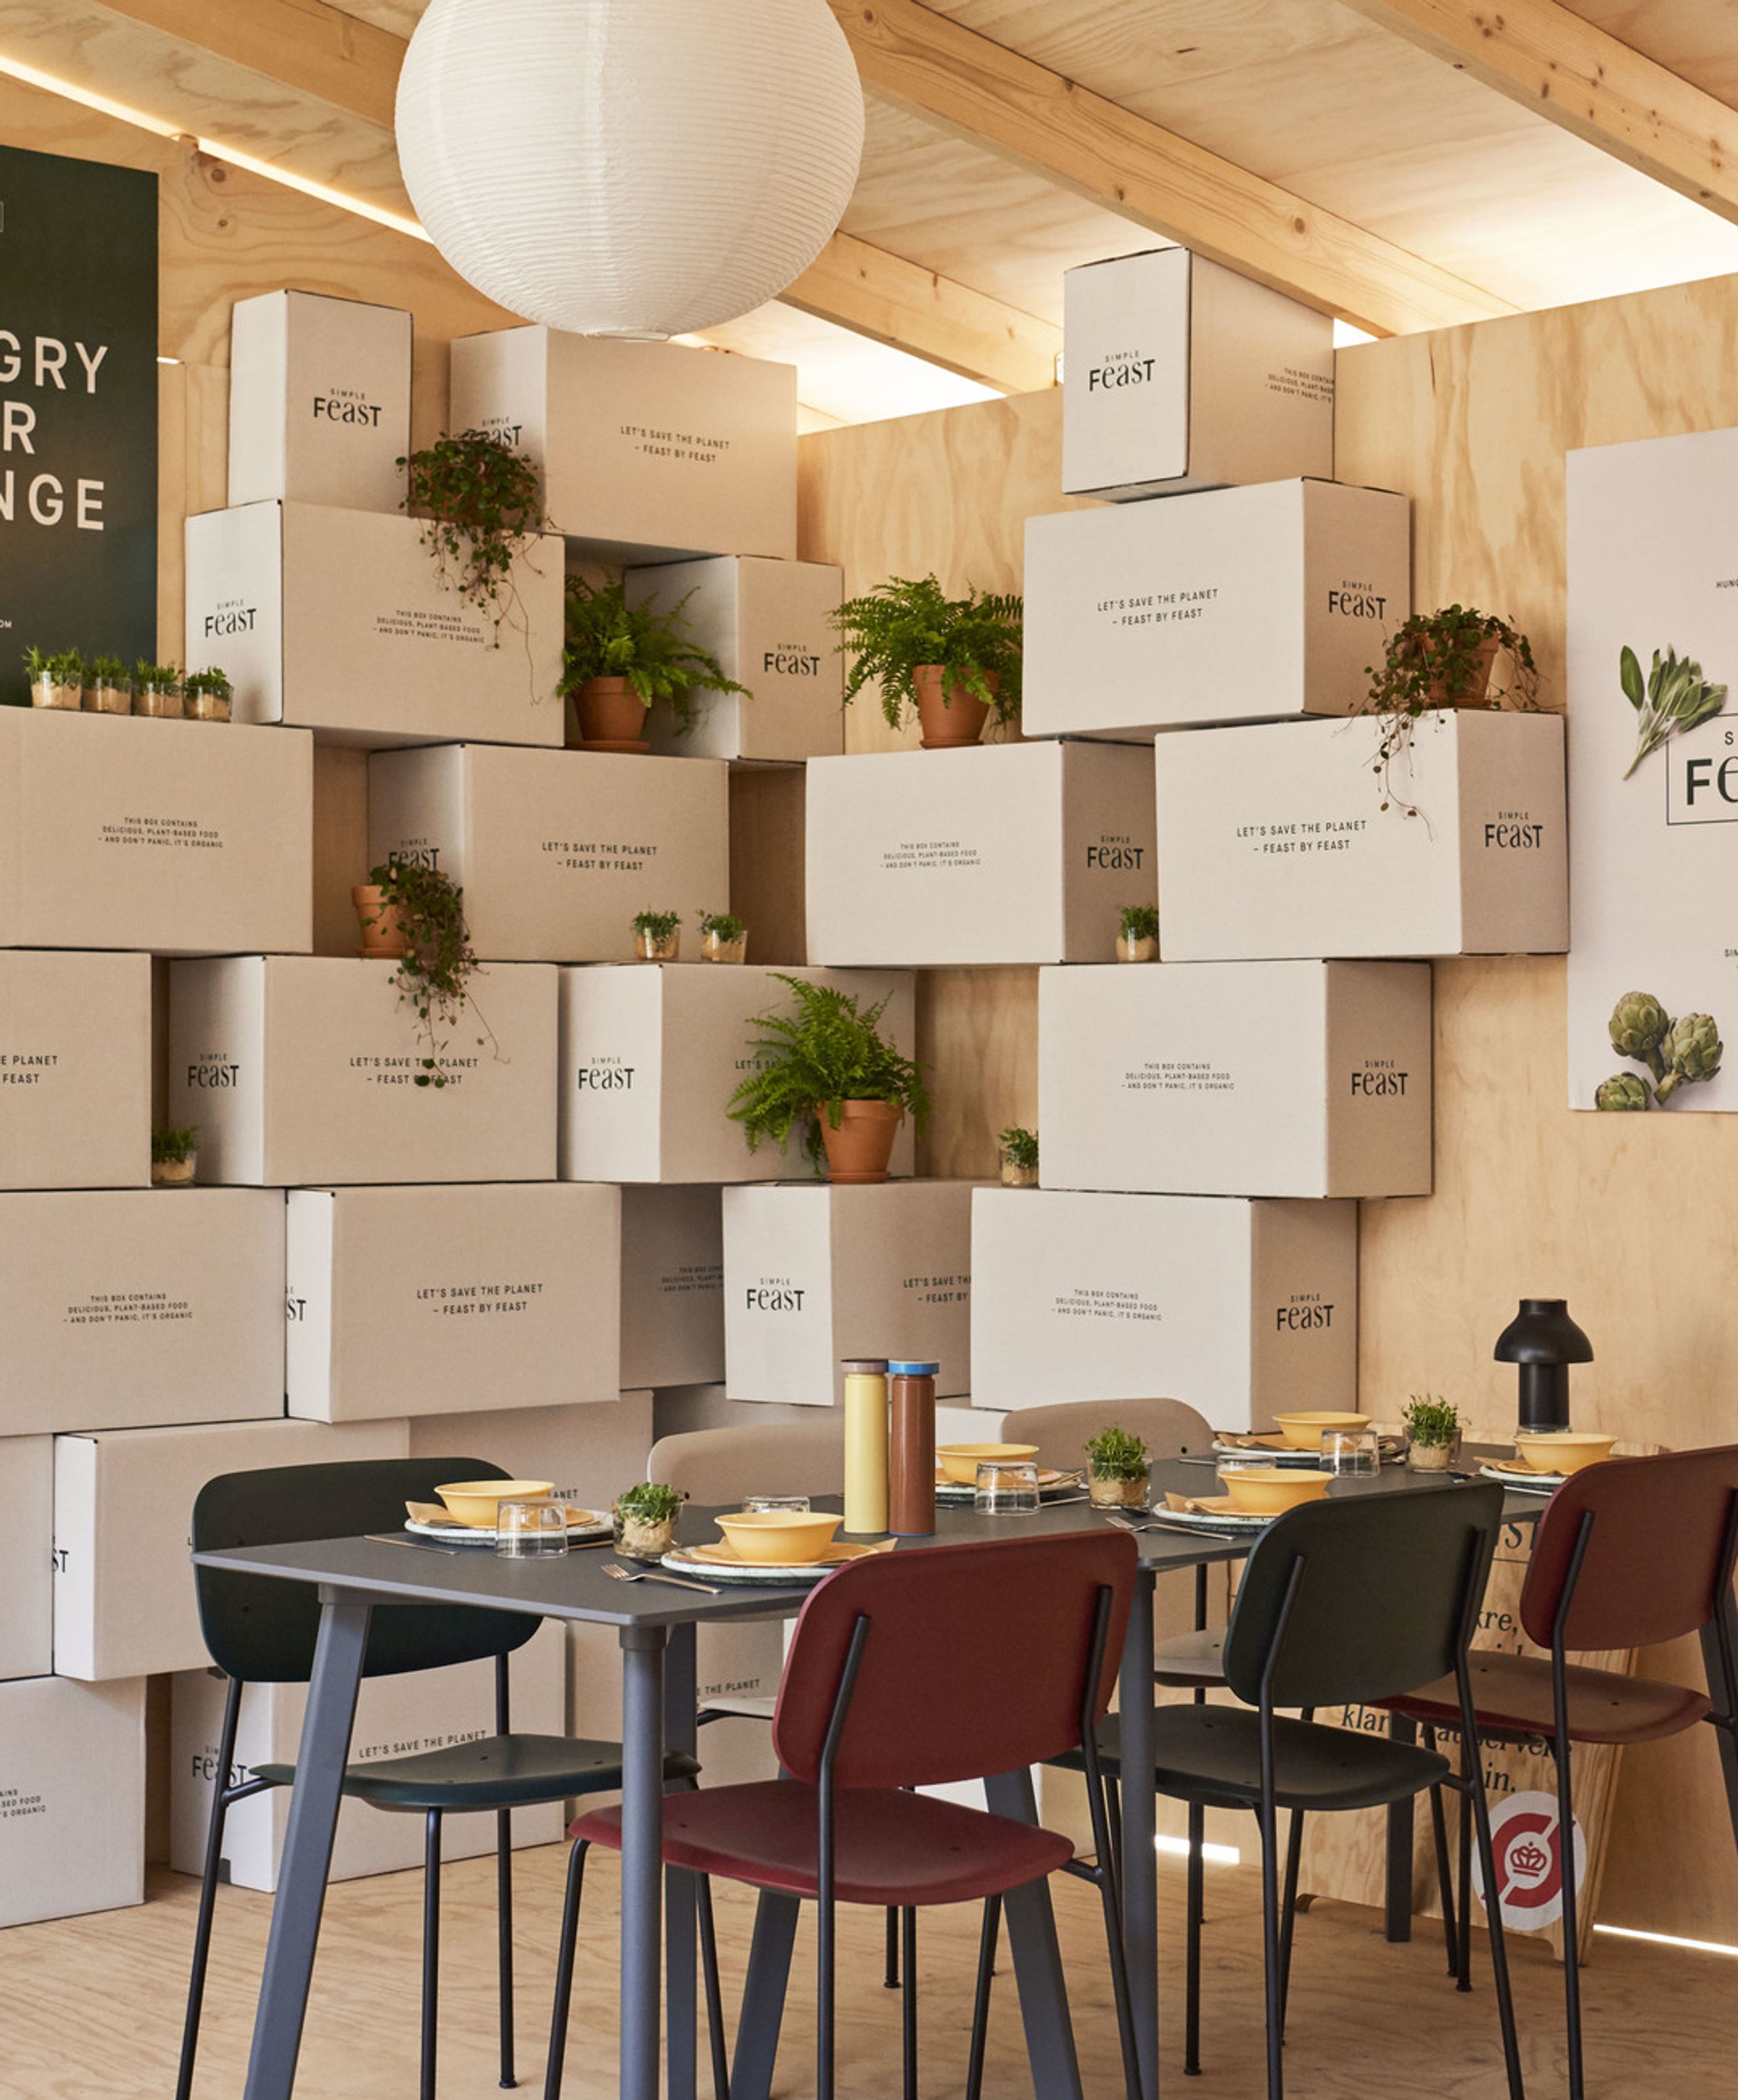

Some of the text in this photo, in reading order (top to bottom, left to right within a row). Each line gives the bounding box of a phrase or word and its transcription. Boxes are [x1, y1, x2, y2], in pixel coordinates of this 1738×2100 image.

[3, 401, 36, 454] R
[621, 426, 729, 449] LET'S SAVE THE PLANET
[644, 445, 716, 462] FEAST BY FEAST
[1098, 589, 1218, 611] LET'S SAVE THE PLANET
[1122, 608, 1202, 625] FEAST BY FEAST
[1724, 731, 1733, 745] S
[1237, 820, 1367, 837] LET'S SAVE THE PLANET
[542, 842, 657, 855] LET'S SAVE THE PLANET
[1263, 840, 1350, 853] FEAST BY FEAST
[566, 860, 643, 870] FEAST BY FEAST
[13, 1055, 57, 1066] PLANET
[350, 1057, 380, 1067] LET'S
[384, 1057, 410, 1067] SAVE
[439, 1058, 479, 1067] PLANET
[735, 1061, 760, 1069] LET'S
[3, 1073, 39, 1084] FEAST
[377, 1075, 409, 1084] FEAST
[904, 1276, 953, 1288] LET'S SAVE
[417, 1284, 542, 1299] LET'S SAVE THE PLANET
[926, 1292, 967, 1302] FEAST BY
[1291, 1293, 1320, 1303] SIMPLE
[443, 1302, 527, 1314] FEAST BY FEAST
[705, 1684, 721, 1694] THE
[726, 1678, 760, 1691] PLANET
[359, 1731, 486, 1758] LET'S SAVE THE PLANET
[20, 1796, 41, 1805] FOOD
[11, 1805, 46, 1816] ORGANIC
